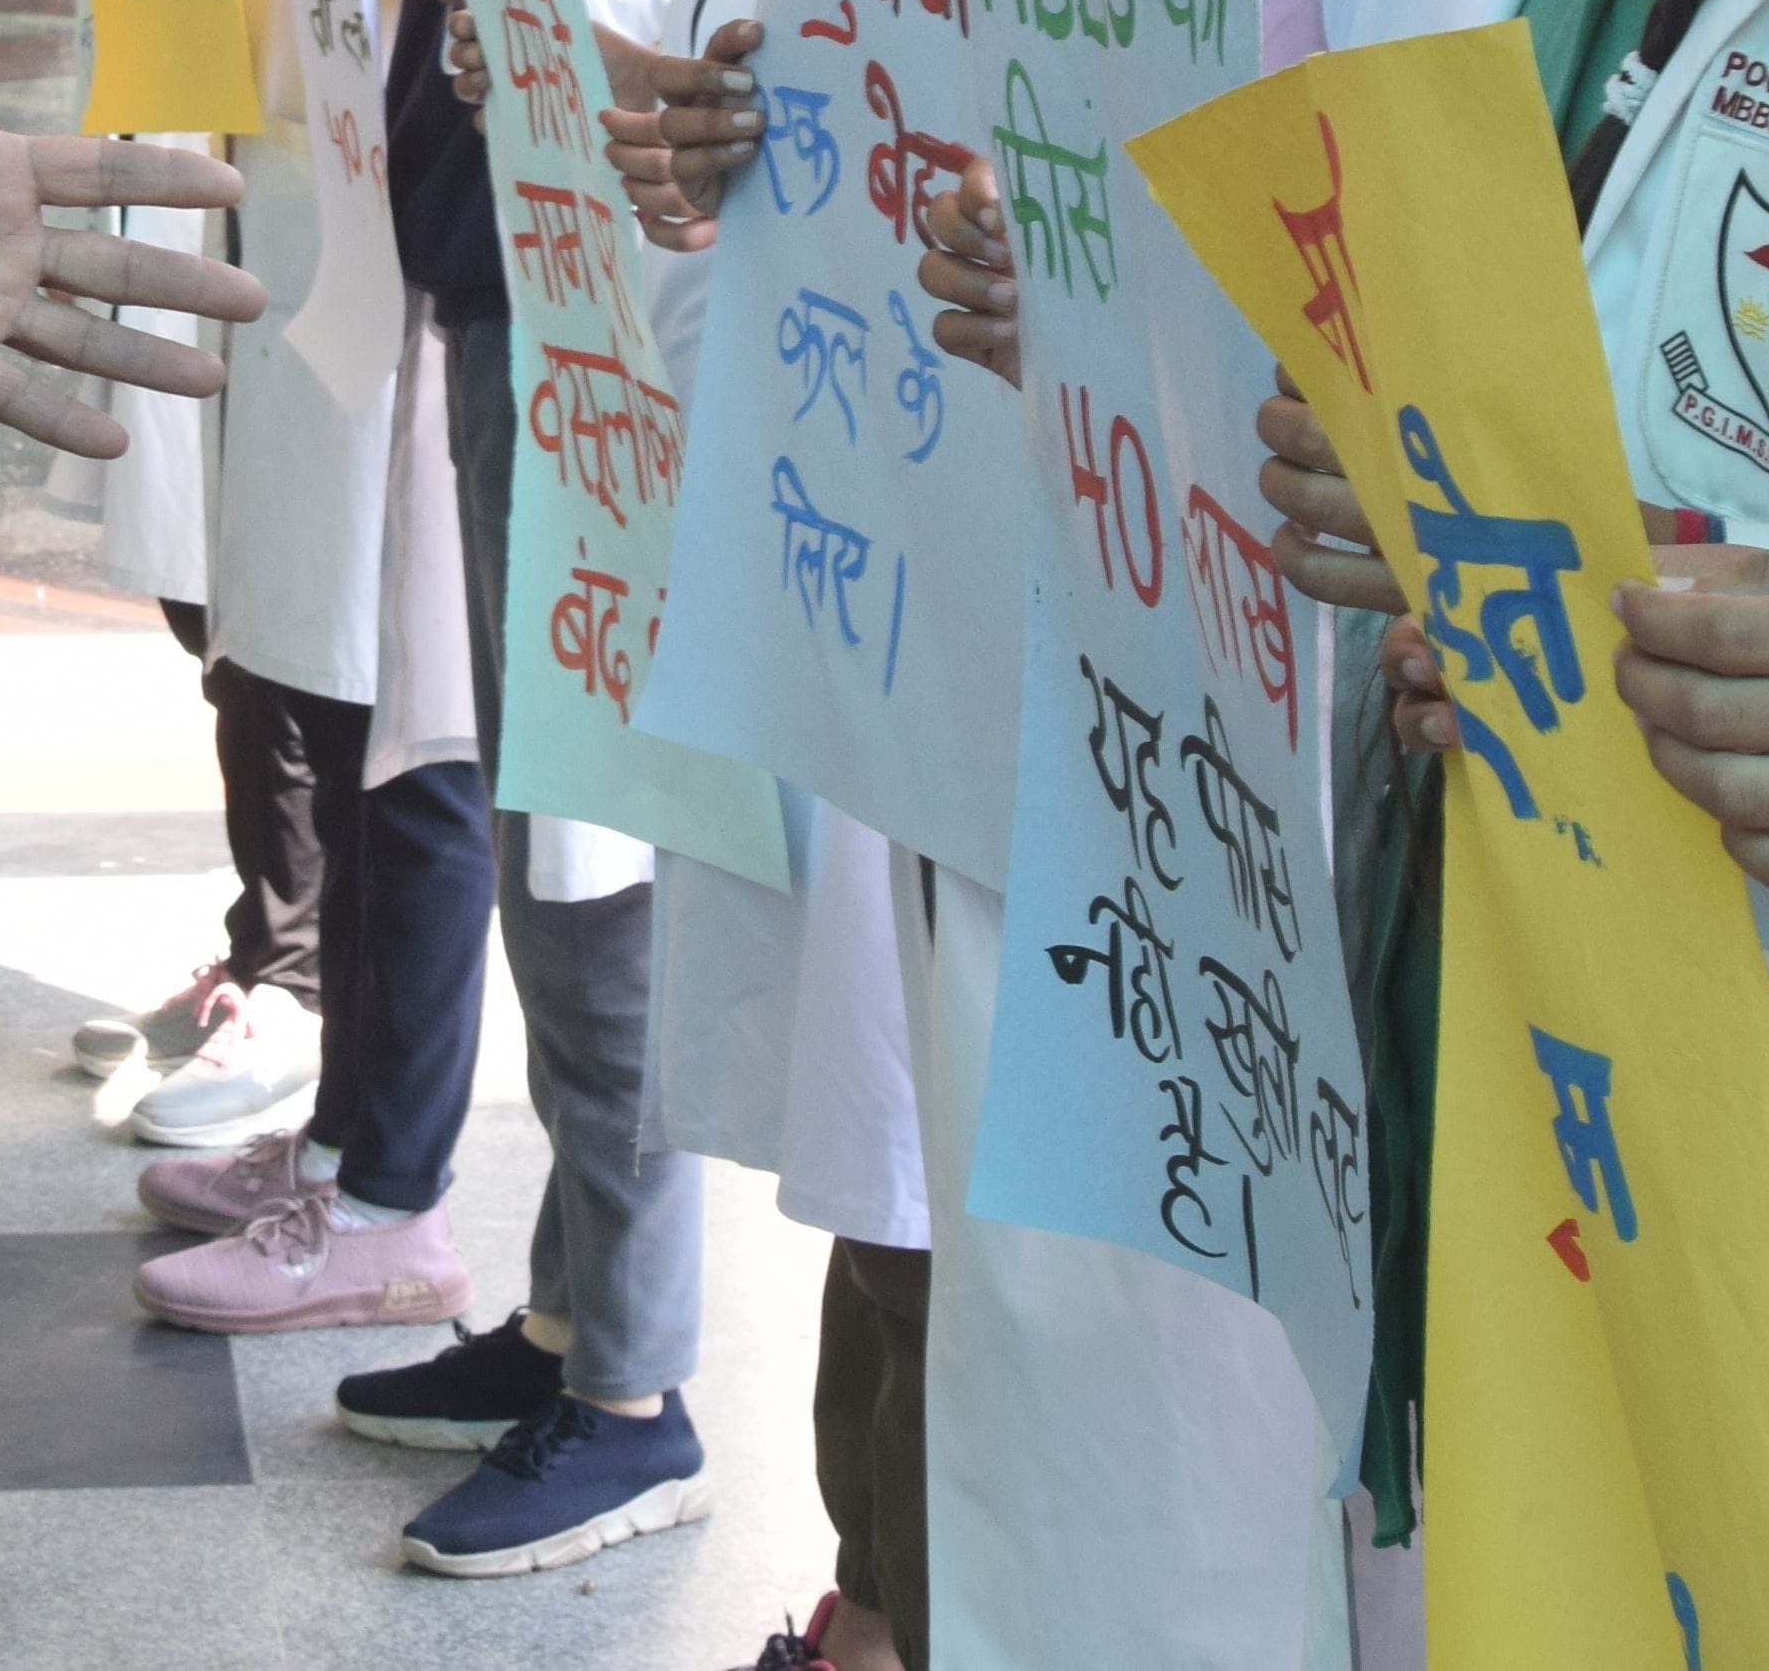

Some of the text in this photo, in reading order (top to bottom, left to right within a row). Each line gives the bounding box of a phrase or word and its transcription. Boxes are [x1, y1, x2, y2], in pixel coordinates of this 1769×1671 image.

[991, 57, 1119, 306] फीस
[778, 286, 870, 446] कल
[887, 289, 946, 465] के
[1059, 381, 1164, 610] 40
[1180, 482, 1298, 755] लाख
[1079, 652, 1303, 963] यह फीस
